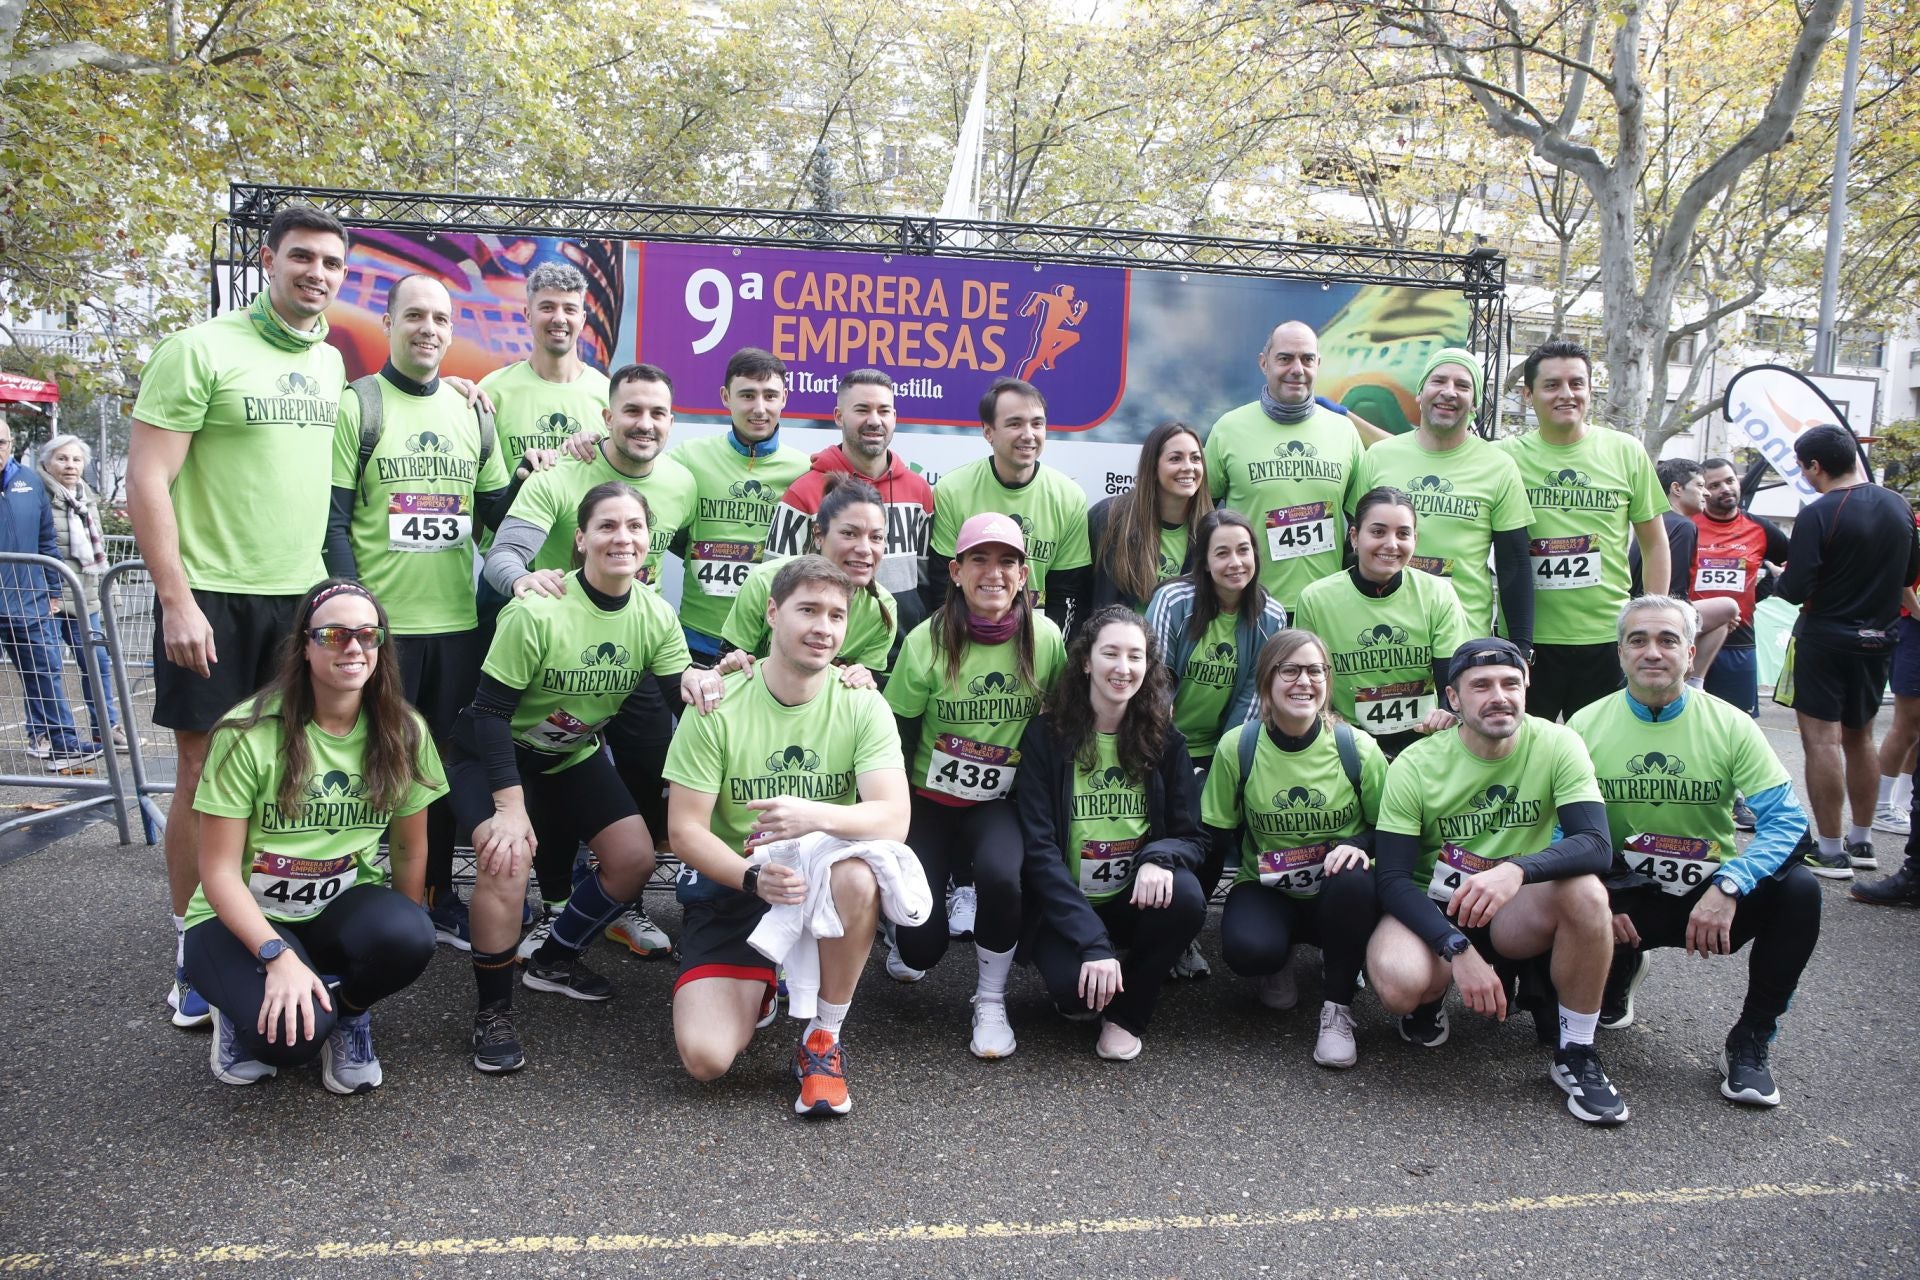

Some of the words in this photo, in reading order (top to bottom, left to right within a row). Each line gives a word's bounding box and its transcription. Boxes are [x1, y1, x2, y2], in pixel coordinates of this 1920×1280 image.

[773, 270, 949, 318] CARRERA
[961, 280, 1010, 321] DE
[771, 315, 1006, 372] EMPRESAS
[797, 371, 841, 394] Nort
[892, 375, 943, 400] astilla
[1248, 459, 1342, 481] ENTREPINARES
[1105, 483, 1135, 495] Gro
[401, 516, 460, 541] 453
[1278, 522, 1325, 548] 451
[697, 562, 750, 586] 446
[1537, 556, 1590, 579] 442
[1701, 570, 1738, 585] 552
[1366, 698, 1419, 724] 441
[730, 770, 856, 800] ENTREPINARES
[940, 759, 1001, 790] 438
[1655, 843, 1691, 852] EMPRESAS
[1656, 836, 1682, 844] CARRERA
[290, 865, 333, 874] EMPRESAS
[291, 860, 323, 868] CARRERA
[325, 860, 335, 868] DE
[1284, 852, 1317, 863] EMPRESAS
[1092, 860, 1134, 883] 43
[1635, 857, 1703, 886] 436
[263, 878, 342, 906] 440
